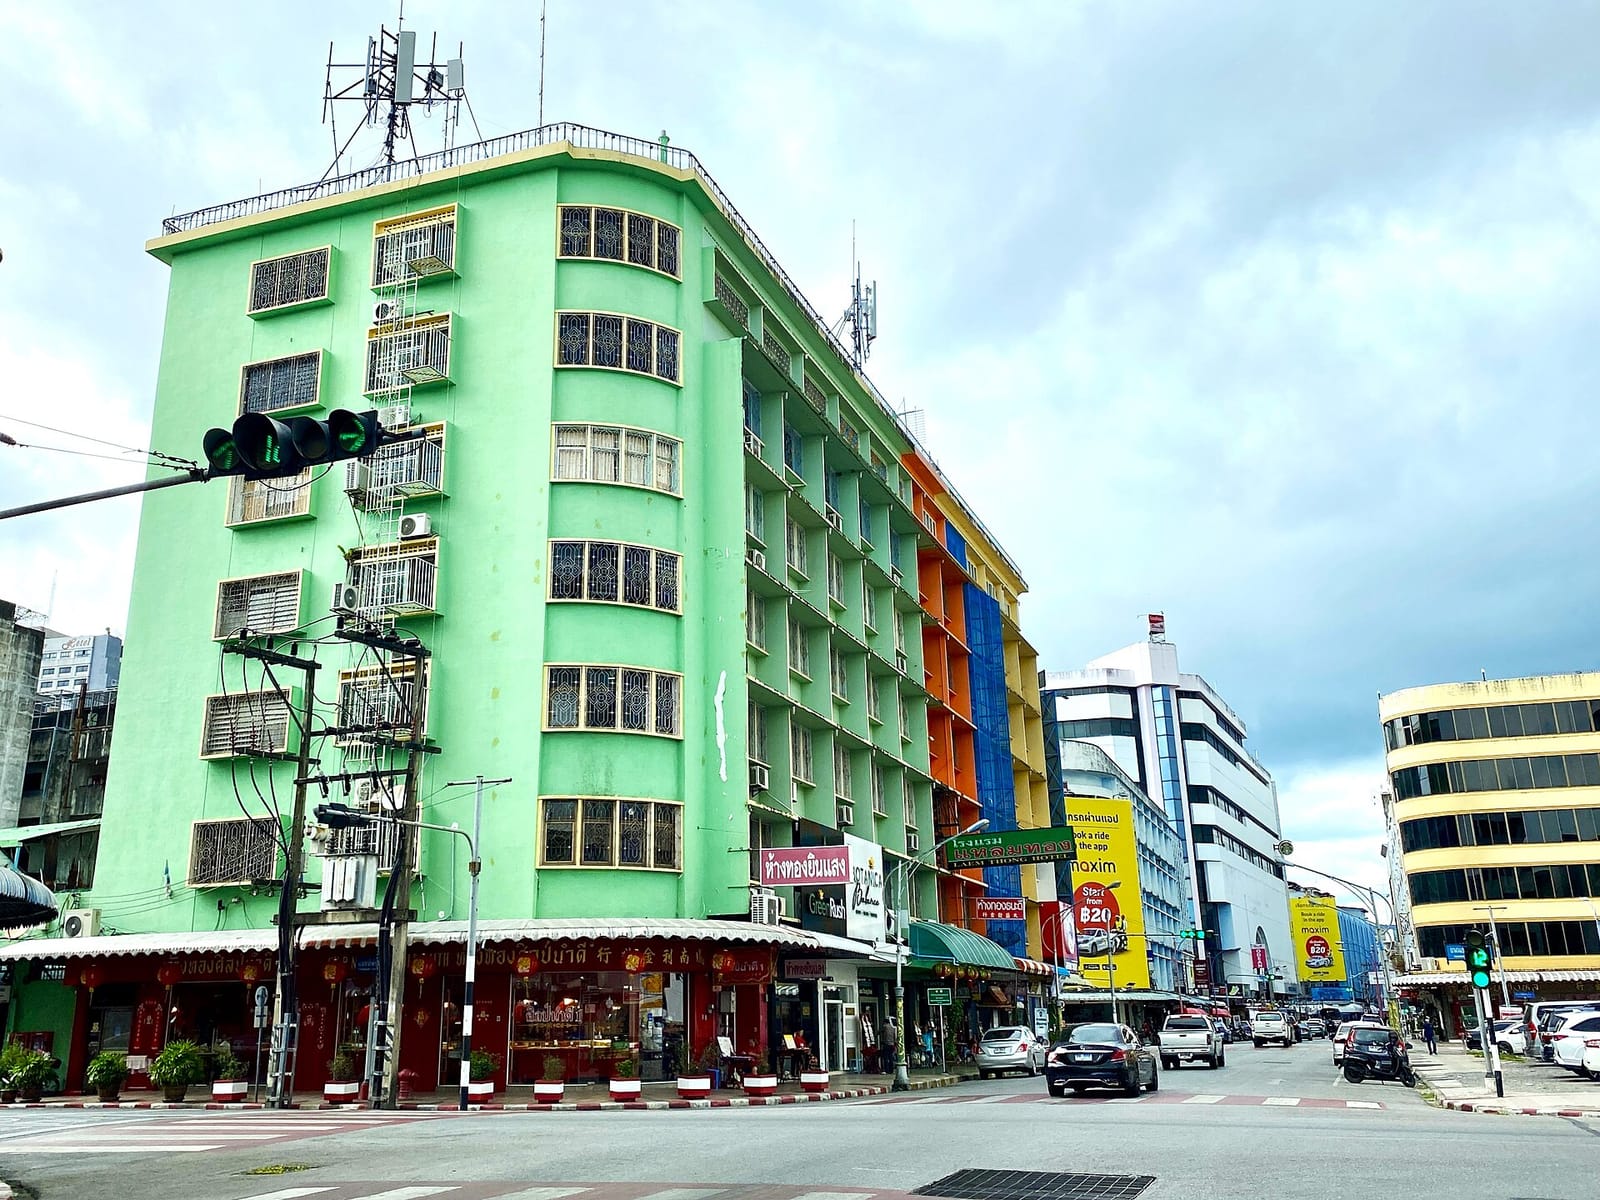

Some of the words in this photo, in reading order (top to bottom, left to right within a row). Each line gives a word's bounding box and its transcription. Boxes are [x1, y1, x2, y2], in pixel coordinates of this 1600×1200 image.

[1067, 811, 1119, 824] กรถผ่านแอป
[1074, 831, 1086, 839] ook
[1094, 832, 1110, 840] ride
[952, 836, 1002, 848] โรงแรม
[1079, 842, 1092, 850] the
[1094, 844, 1108, 852] app
[954, 840, 1072, 860] แหลมทอง
[953, 858, 988, 868] LAEM
[990, 856, 1028, 865] THONG
[1032, 853, 1071, 862] HOTEL
[1070, 858, 1116, 873] maxim
[1082, 886, 1105, 896] Start
[1302, 926, 1330, 934] maxim
